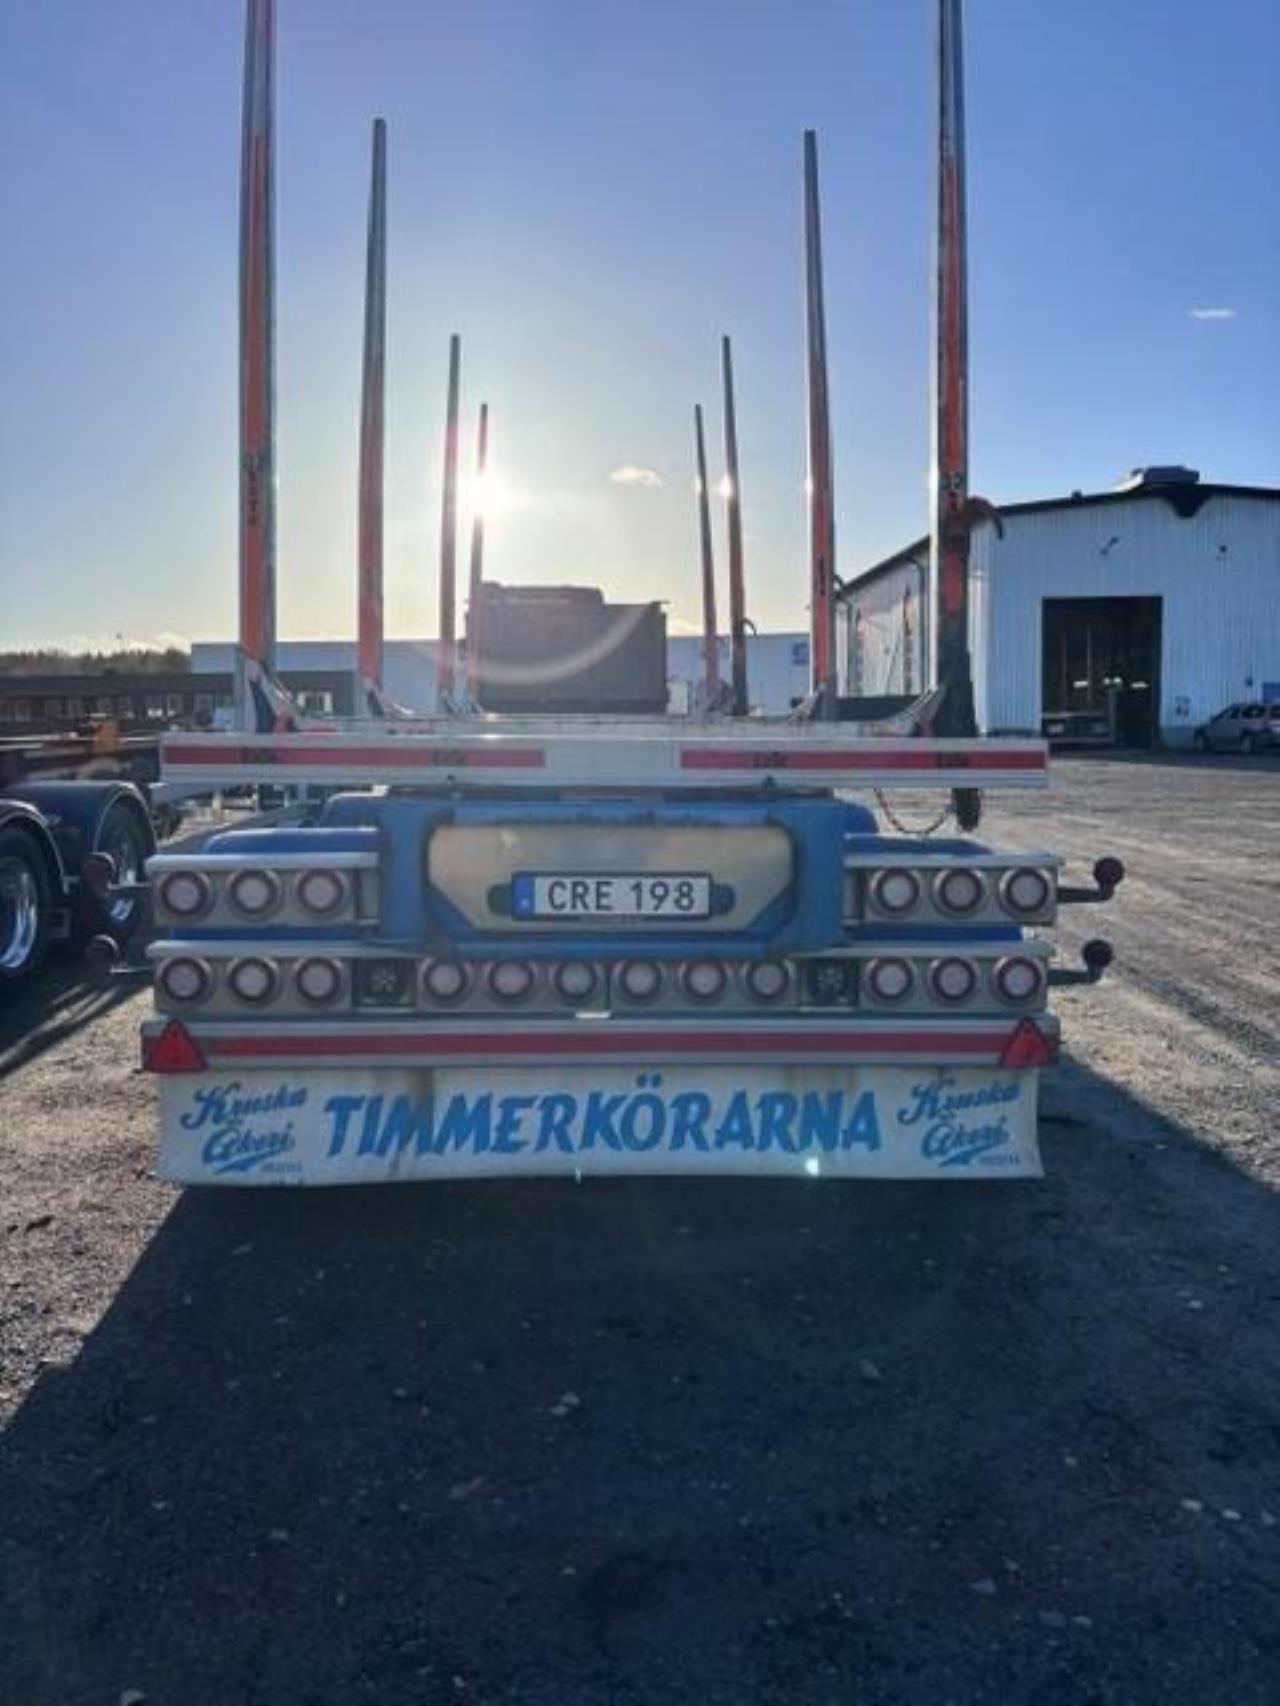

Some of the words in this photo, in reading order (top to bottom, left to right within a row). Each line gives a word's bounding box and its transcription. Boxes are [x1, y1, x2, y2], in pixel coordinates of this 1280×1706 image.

[548, 880, 614, 912] CRE
[630, 880, 696, 912] 198
[324, 1073, 881, 1157] TIMMERKÖRARNA
